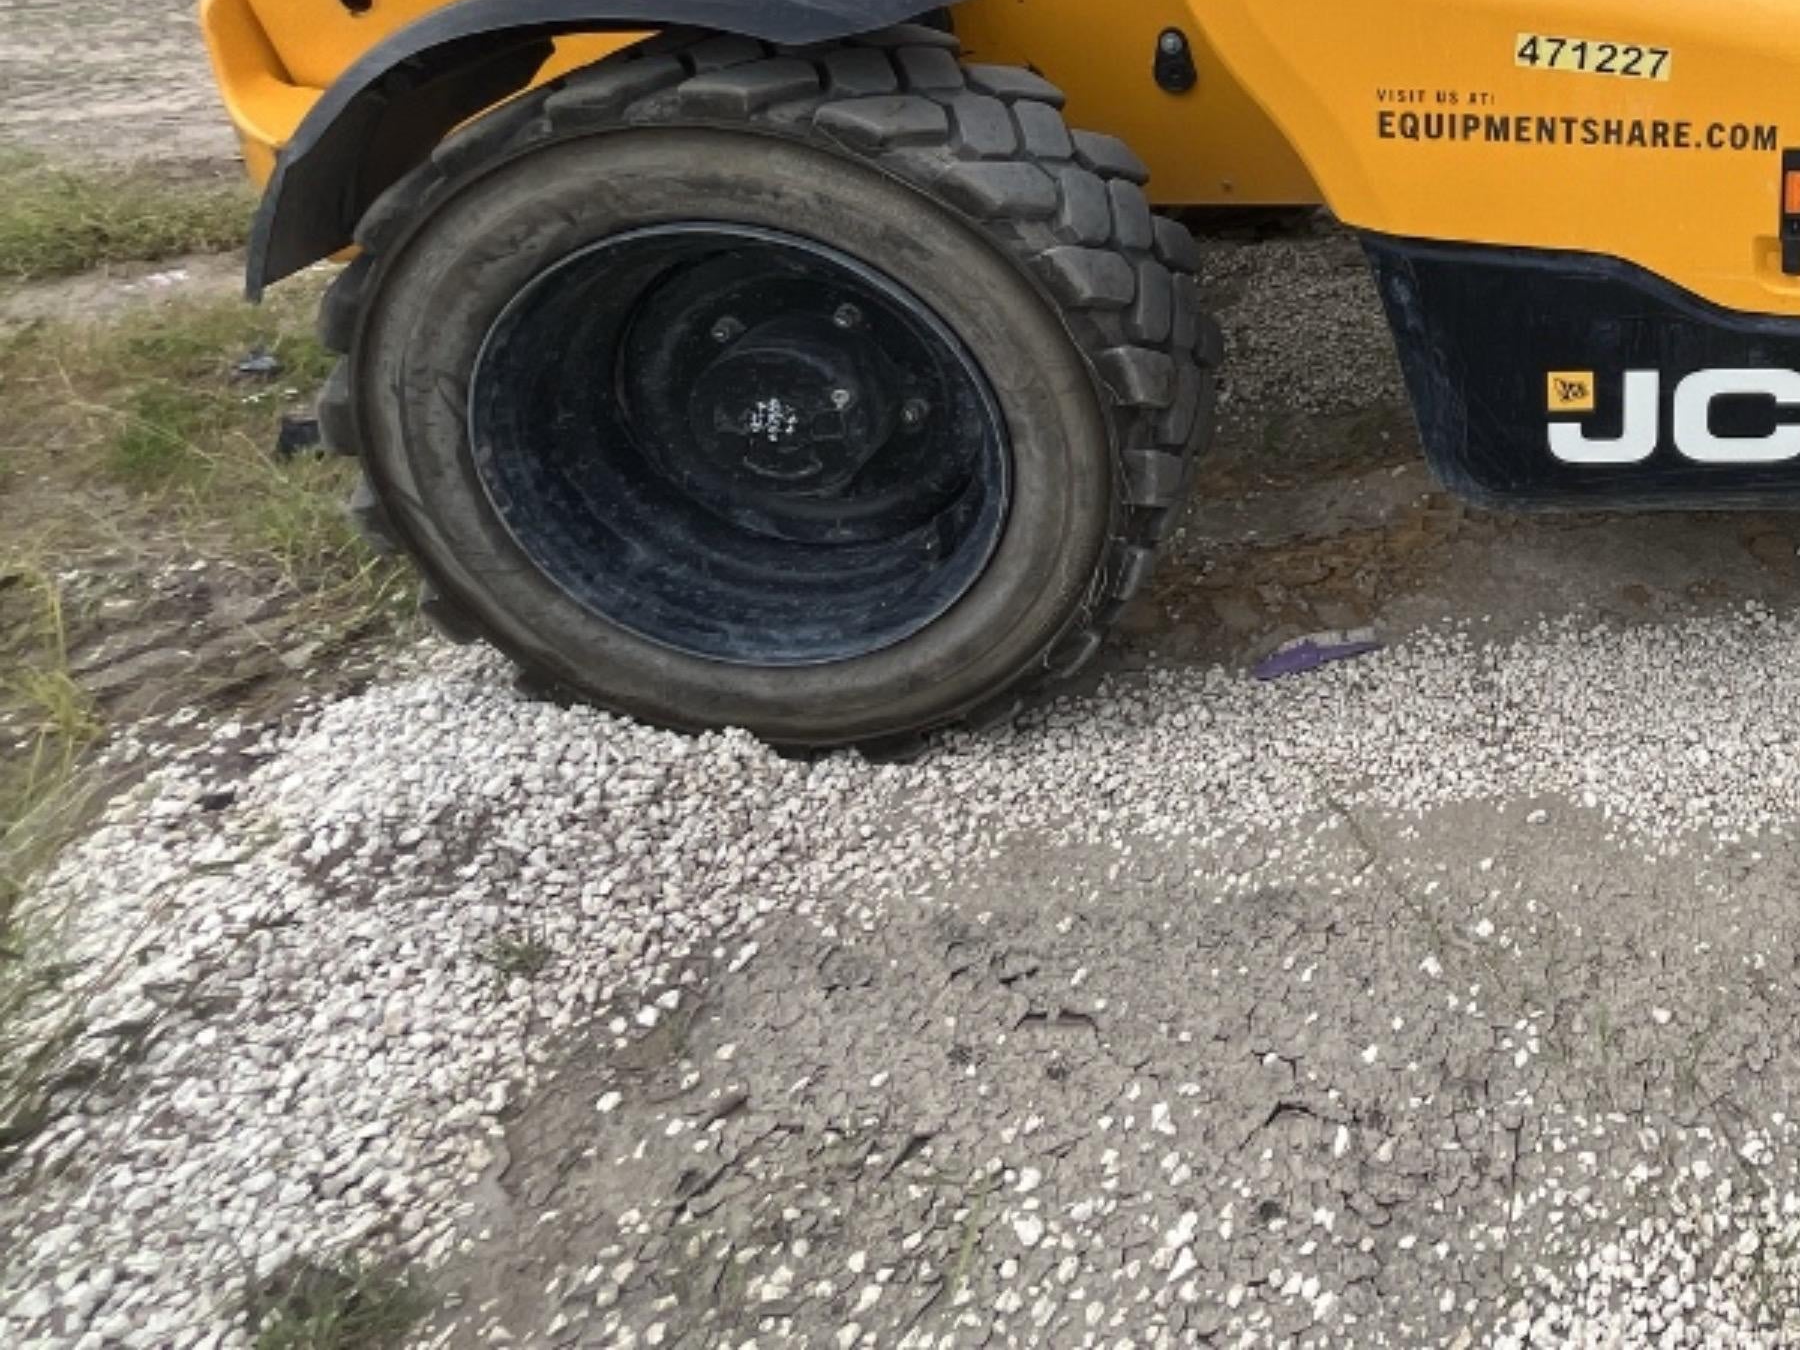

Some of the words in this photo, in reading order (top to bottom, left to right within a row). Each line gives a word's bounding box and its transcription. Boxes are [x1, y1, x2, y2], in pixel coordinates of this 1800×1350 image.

[1516, 34, 1670, 79] 471227
[1376, 88, 1426, 104] VISIT
[1436, 89, 1459, 105] US
[1376, 110, 1779, 152] EQUIPMENTSHARE.COM
